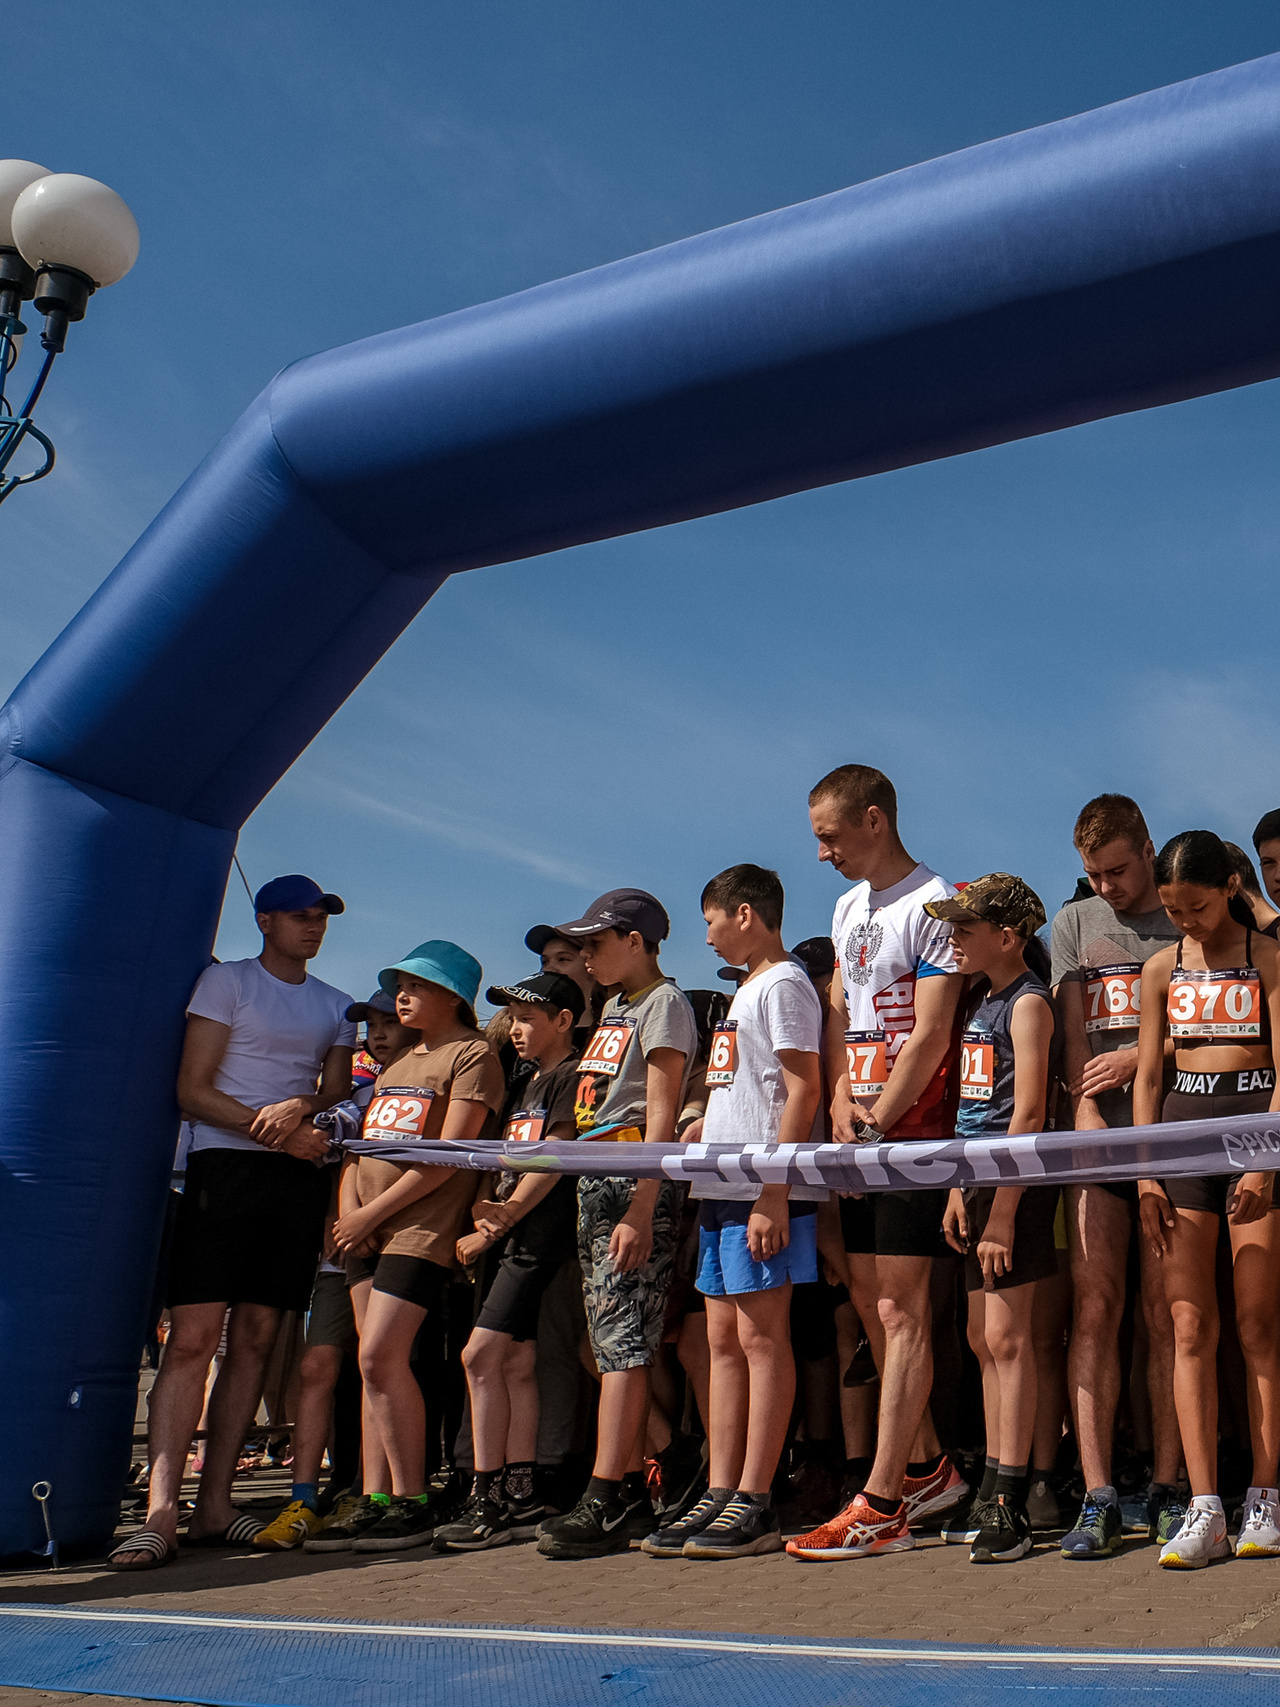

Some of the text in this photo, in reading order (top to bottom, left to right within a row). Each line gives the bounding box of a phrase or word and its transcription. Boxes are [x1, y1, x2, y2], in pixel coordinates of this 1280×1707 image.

[1170, 983, 1253, 1021] 370
[708, 1035, 730, 1069] 6
[366, 1097, 423, 1132] 462
